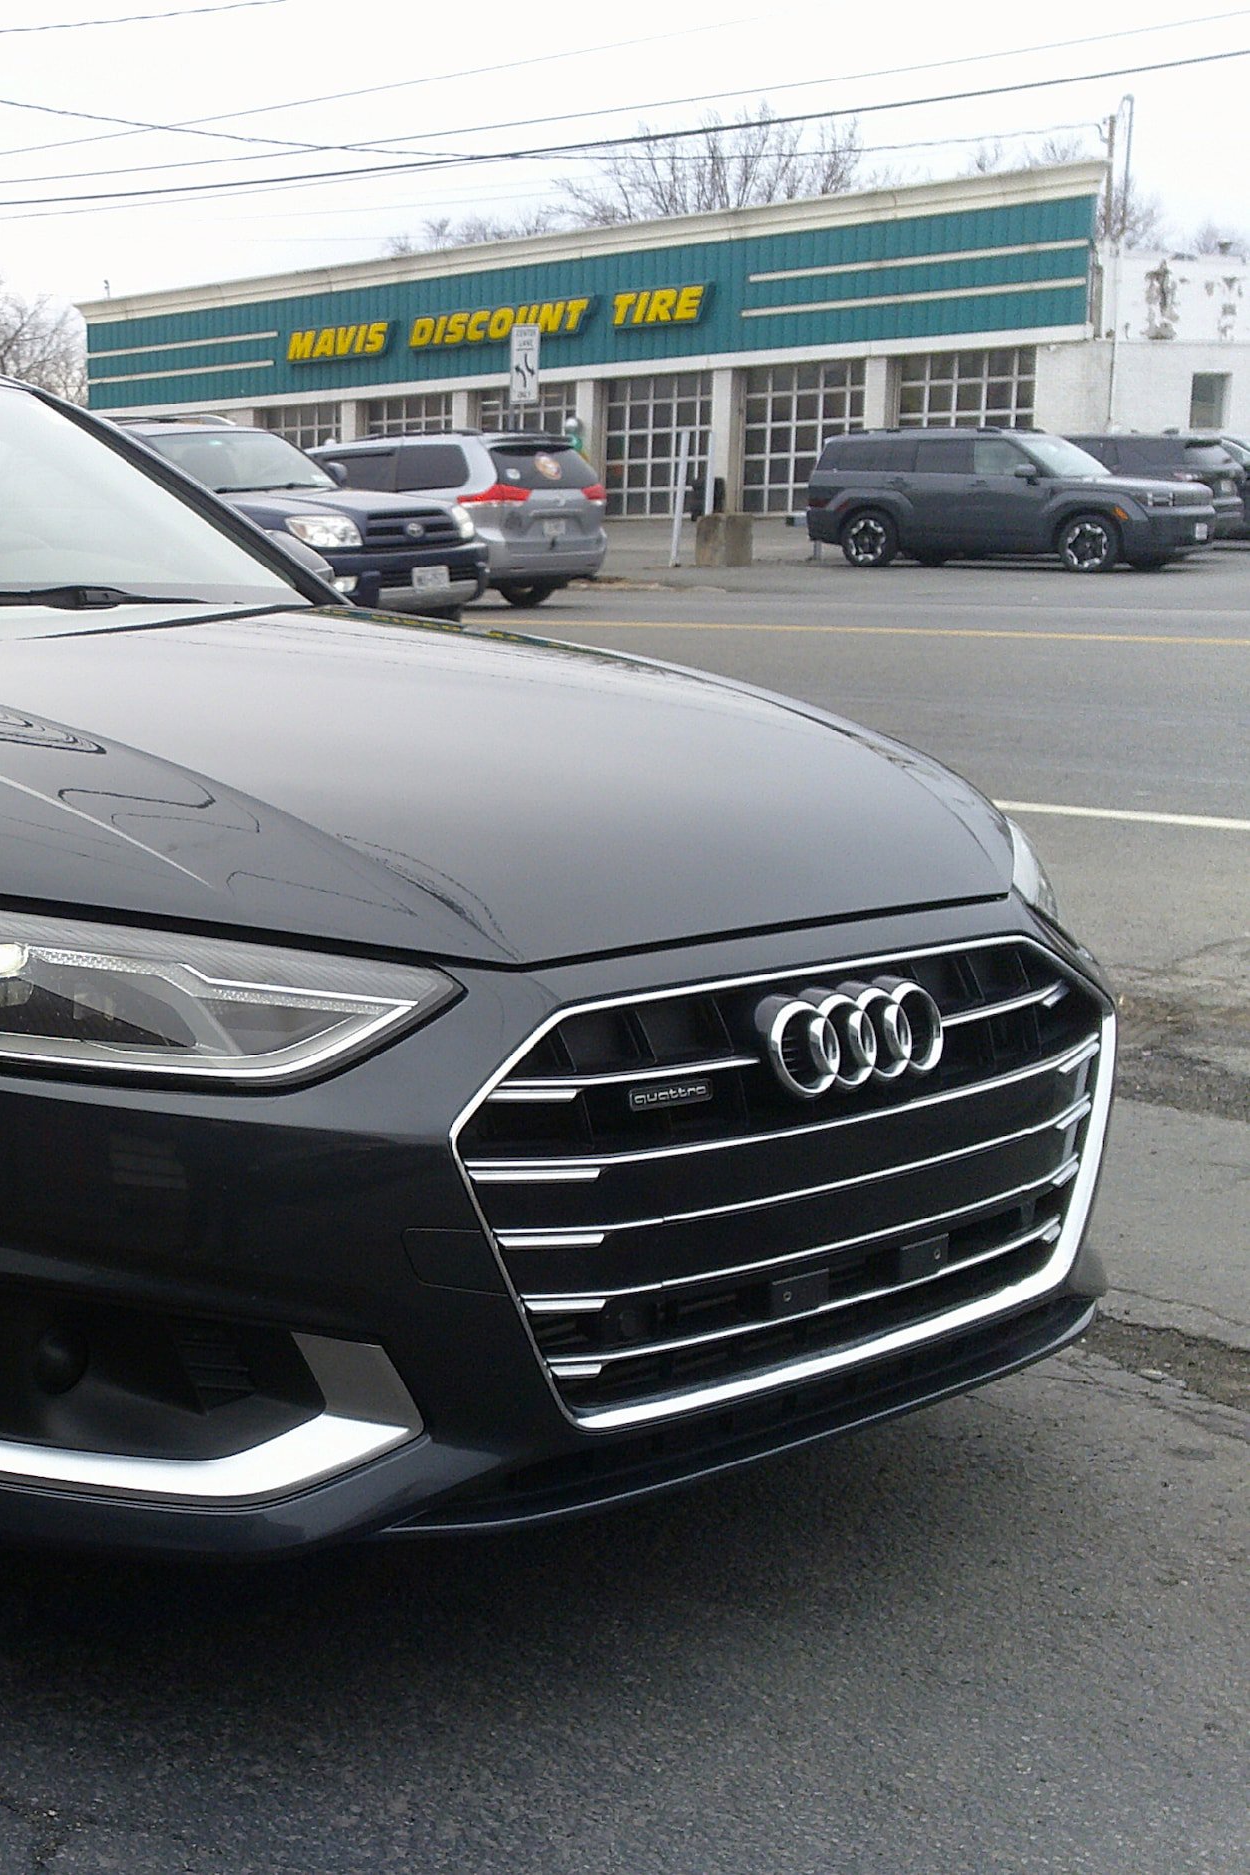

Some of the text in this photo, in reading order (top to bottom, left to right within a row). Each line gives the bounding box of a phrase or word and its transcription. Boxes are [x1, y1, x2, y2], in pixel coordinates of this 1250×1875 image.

[287, 285, 705, 361] MAVIS DISCOUNT TIRE
[634, 1085, 707, 1104] quattro
